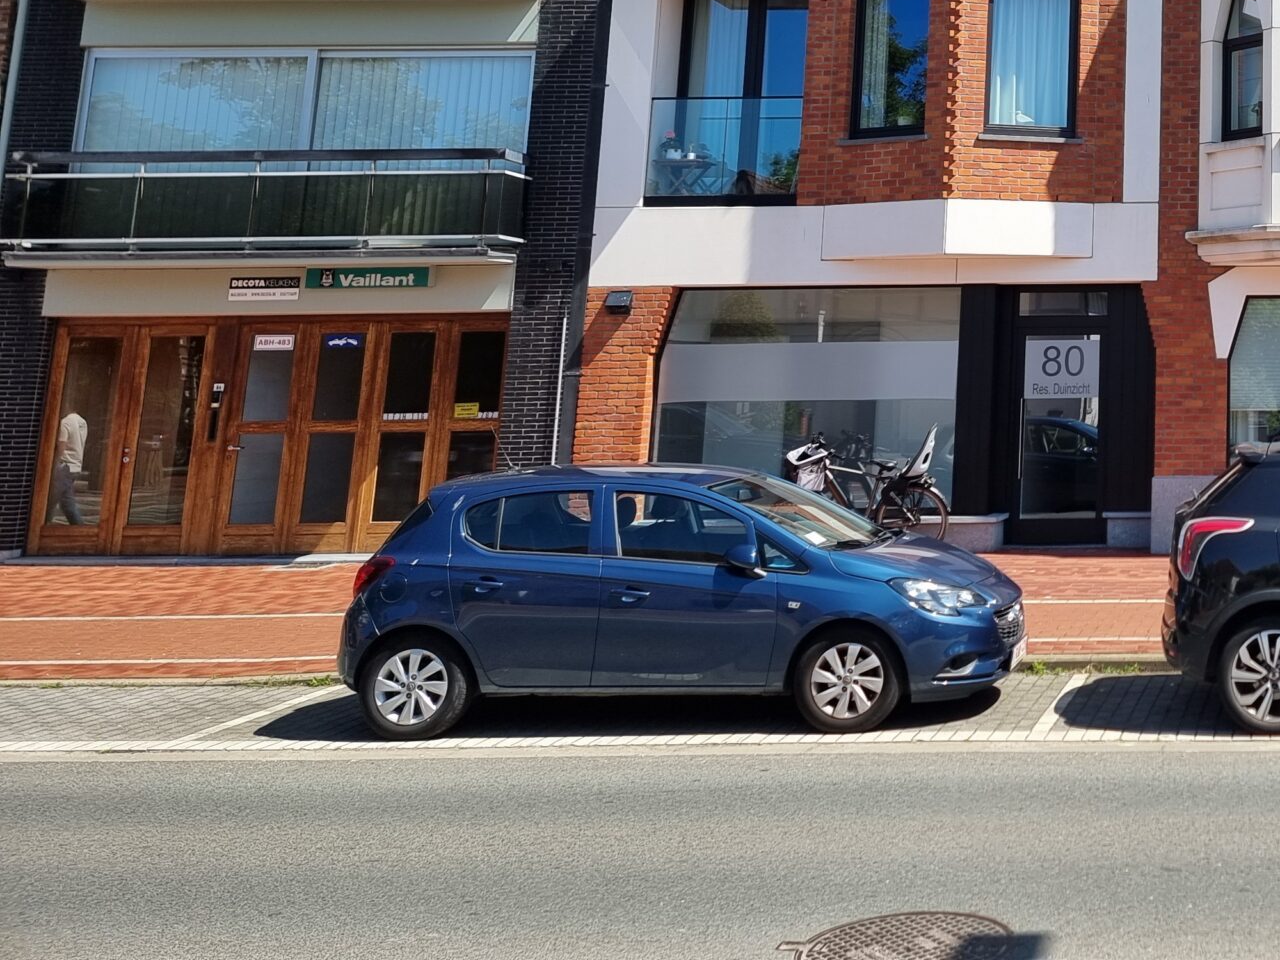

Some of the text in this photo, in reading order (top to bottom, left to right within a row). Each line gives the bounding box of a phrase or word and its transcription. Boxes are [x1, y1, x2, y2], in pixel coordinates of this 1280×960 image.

[231, 279, 265, 287] DECOTA
[339, 273, 415, 287] Vaillant
[1042, 345, 1085, 377] 80
[1032, 382, 1091, 395] Res. Duinzicht
